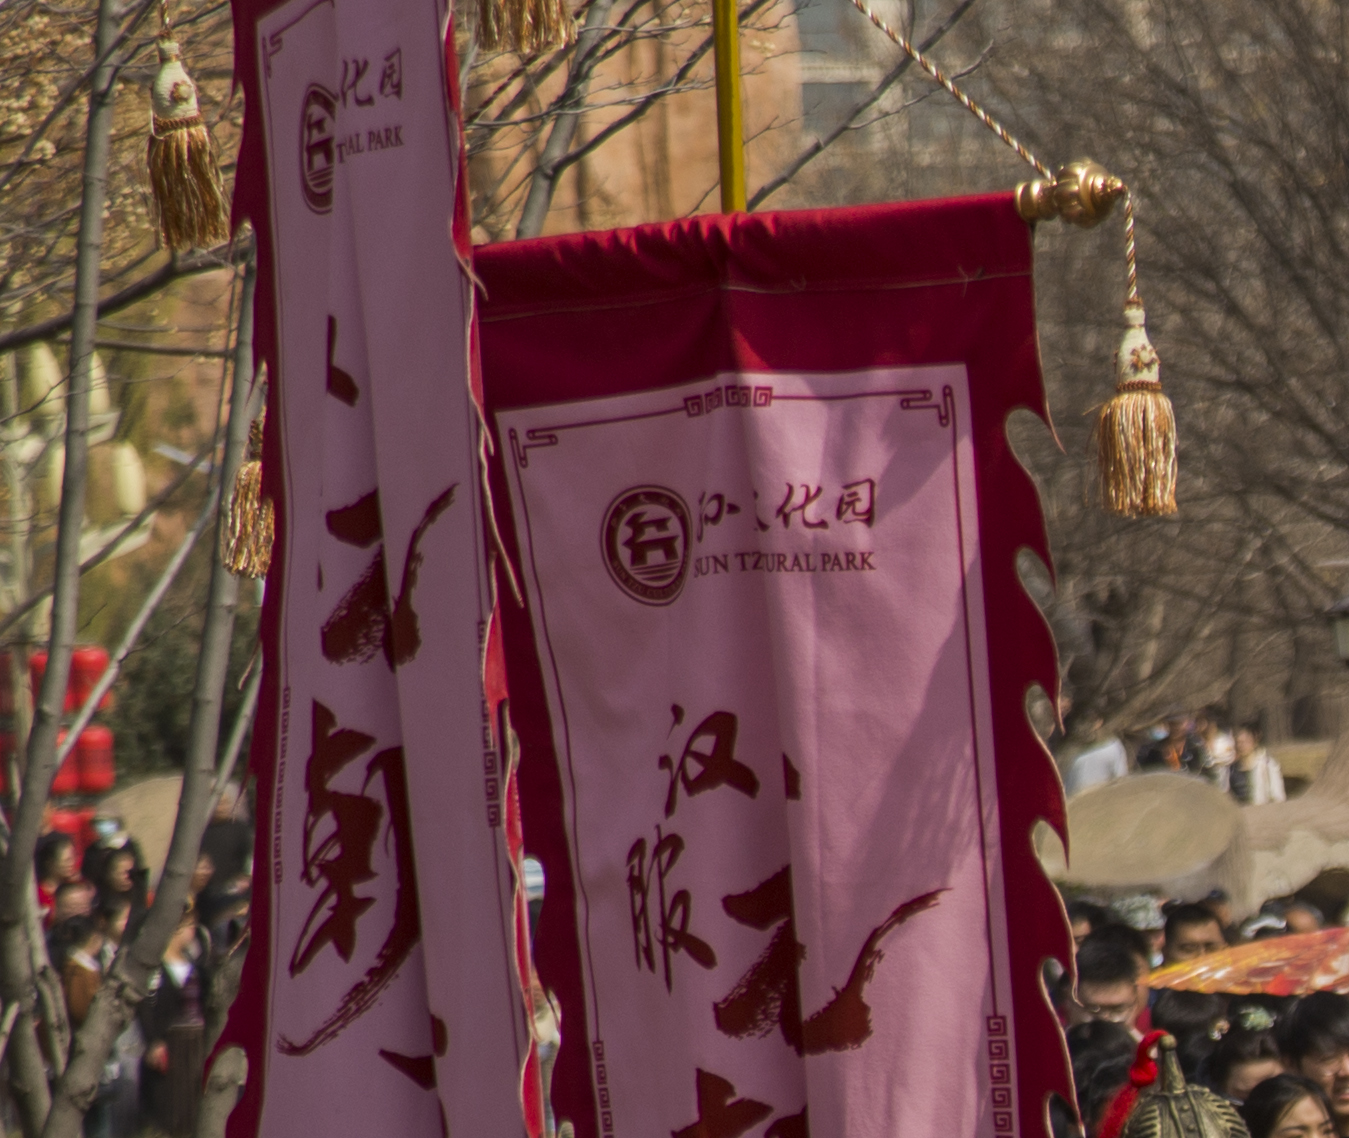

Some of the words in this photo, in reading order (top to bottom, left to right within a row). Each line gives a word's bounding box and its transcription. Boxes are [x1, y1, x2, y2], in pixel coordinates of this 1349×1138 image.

[367, 124, 405, 152] PARK
[693, 552, 730, 579] SUN
[820, 550, 877, 571] PARK
